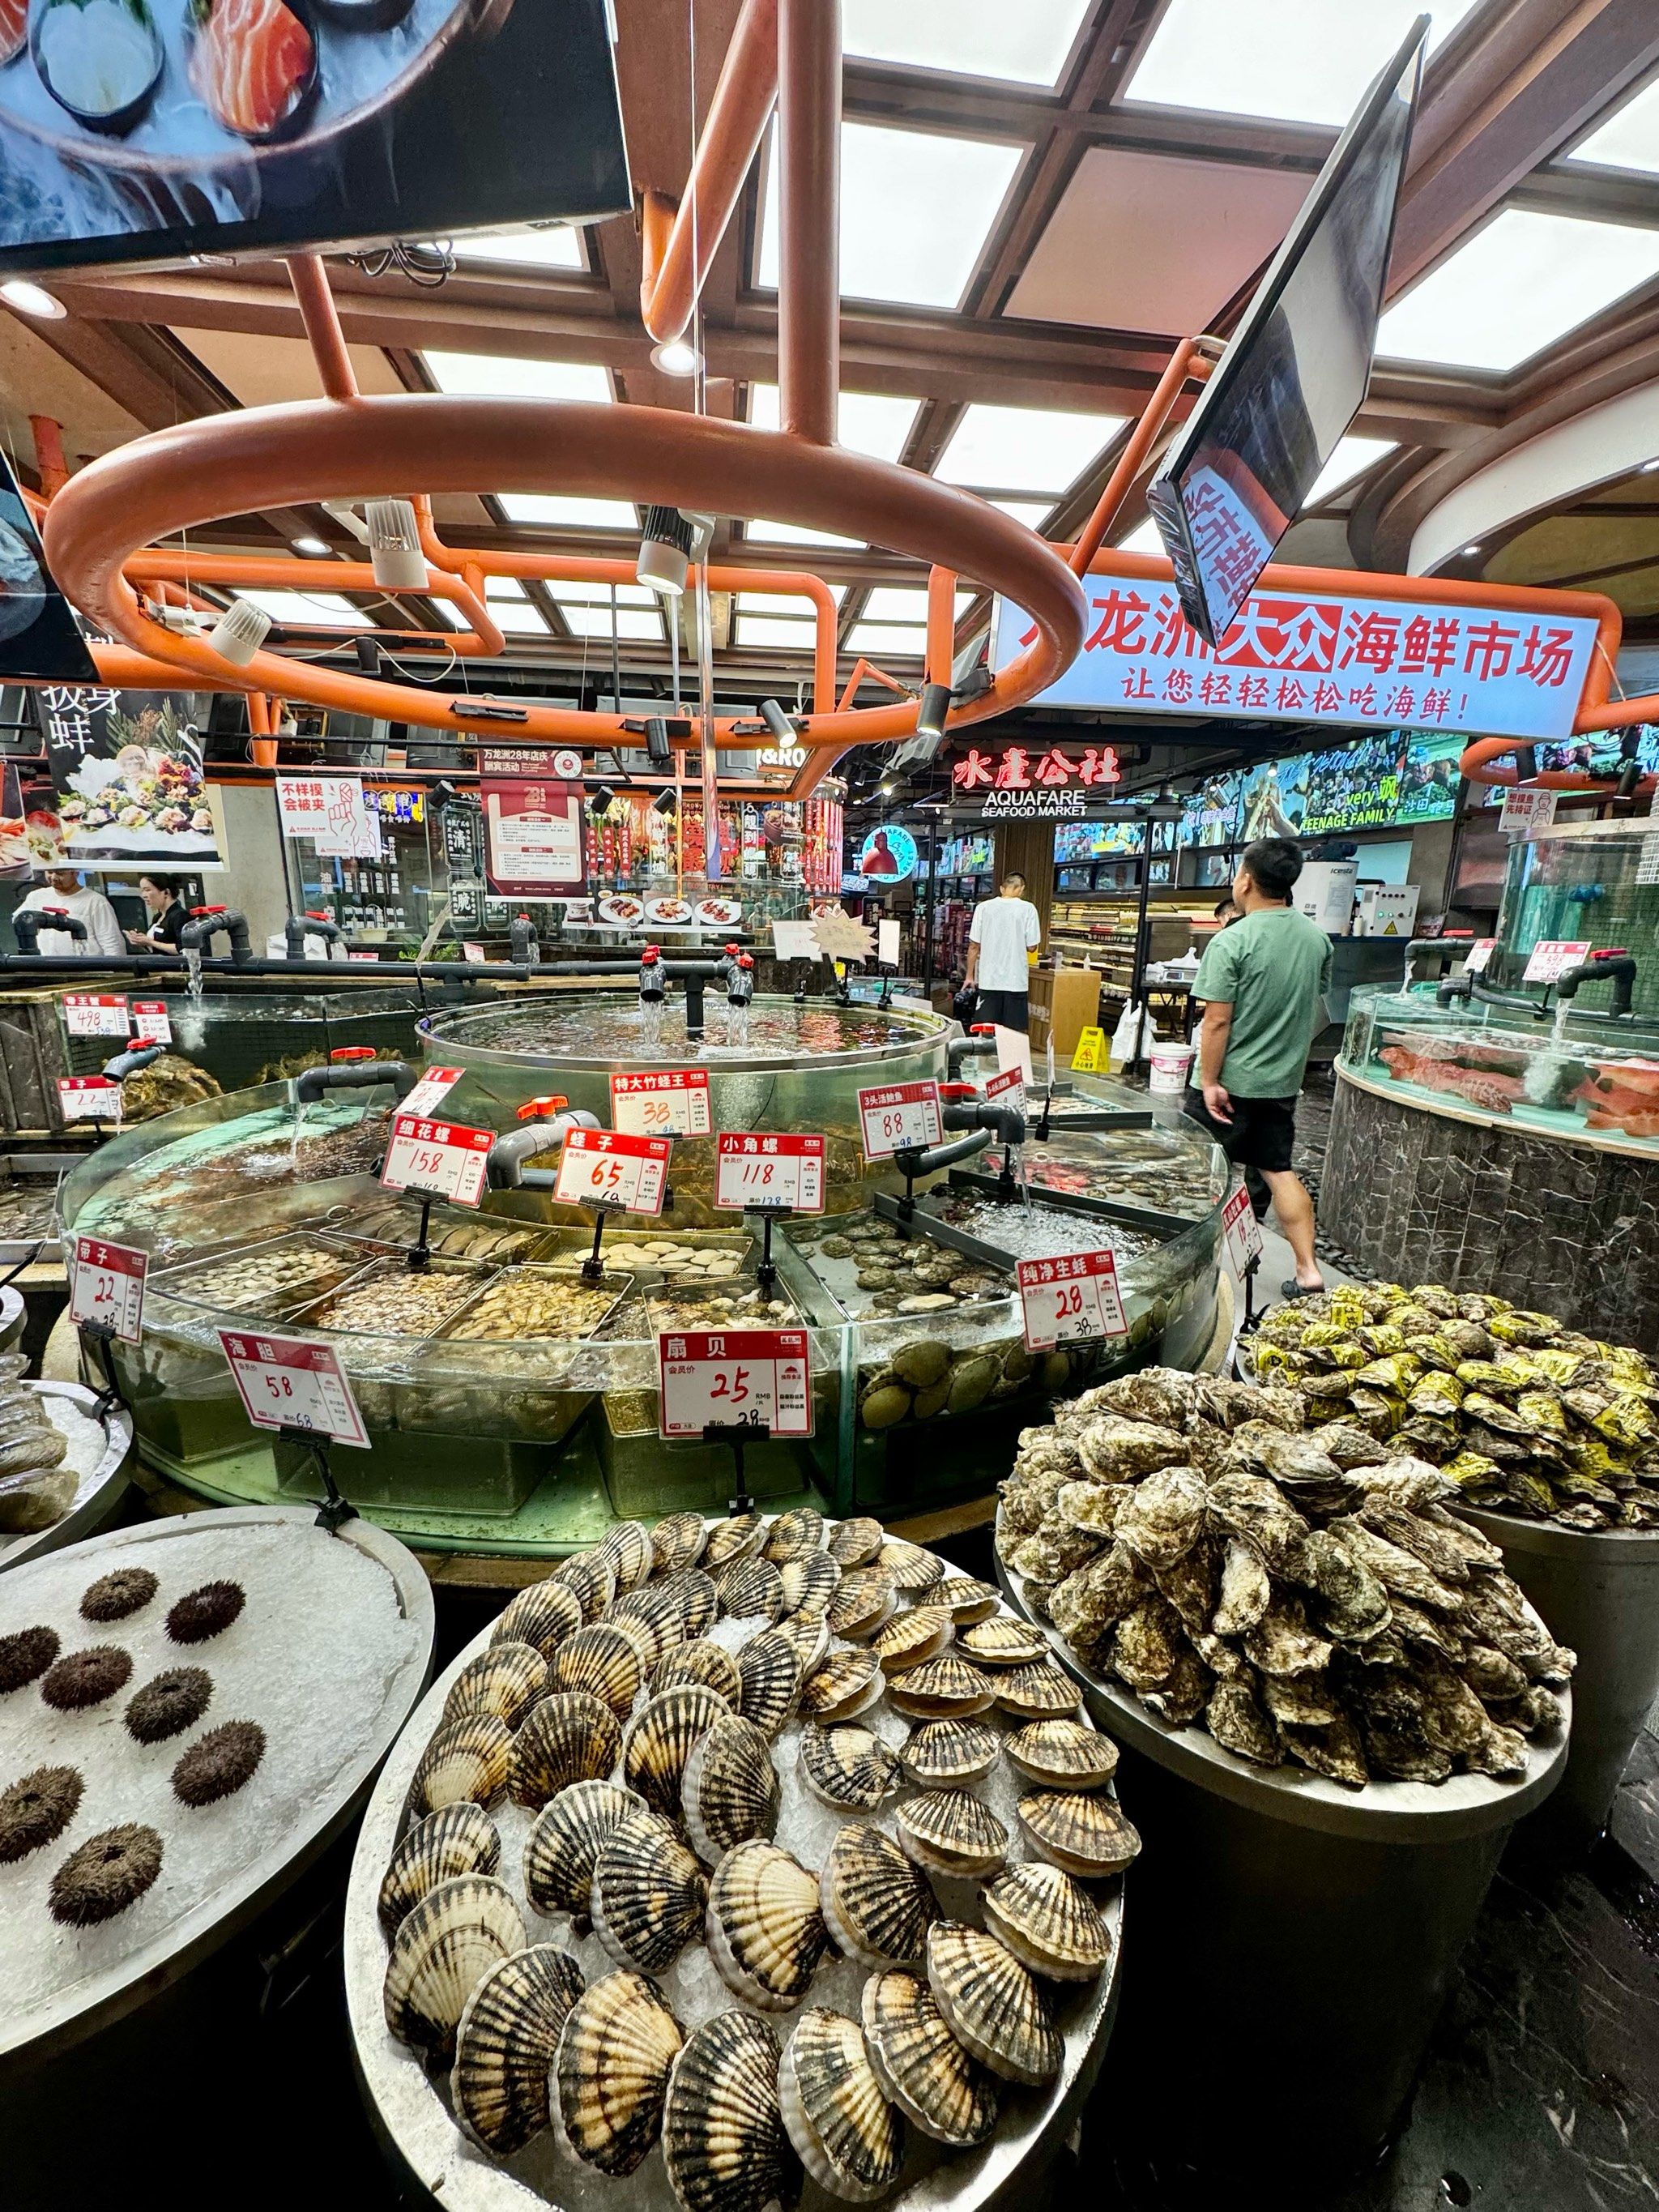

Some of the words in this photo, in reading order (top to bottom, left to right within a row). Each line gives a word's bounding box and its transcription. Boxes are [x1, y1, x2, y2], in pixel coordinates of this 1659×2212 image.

[1019, 589, 1574, 688] 龙洲大众海鲜市场
[1120, 666, 1468, 724] 让您轻轻松松吃海鲜!
[484, 749, 548, 762] 万龙洲28年店庆
[284, 797, 326, 811] 会被夹
[985, 790, 1085, 806] AQUAFARE
[1346, 791, 1375, 808] very
[981, 806, 1034, 818] SEAFOOD
[1038, 805, 1088, 817] MARKET
[1303, 813, 1349, 831] TEENAGE
[1350, 807, 1395, 826] FAMILY
[77, 1010, 100, 1027] 498
[615, 1074, 685, 1091] 特大竹蛏王
[864, 1091, 903, 1106] 3头活鲍鱼
[642, 1101, 671, 1125] 38
[399, 1120, 451, 1142] 细花螺
[883, 1112, 903, 1138] 88
[569, 1131, 613, 1151] 蛏子
[723, 1136, 778, 1154] 小角螺
[409, 1148, 444, 1173] 158
[591, 1159, 624, 1188] 65
[743, 1164, 774, 1184] 118
[762, 1196, 782, 1205] 128
[1022, 1257, 1087, 1283] 纯净生蚝
[95, 1276, 115, 1303] 22
[1056, 1285, 1082, 1319] 28
[1074, 1317, 1092, 1337] 38
[228, 1337, 277, 1362] 海胆
[667, 1337, 727, 1359] 扇贝
[668, 1365, 695, 1374] 会员价
[266, 1375, 292, 1398] 58
[710, 1366, 750, 1403] 25
[296, 1413, 313, 1429] 68
[736, 1409, 759, 1426] 28
